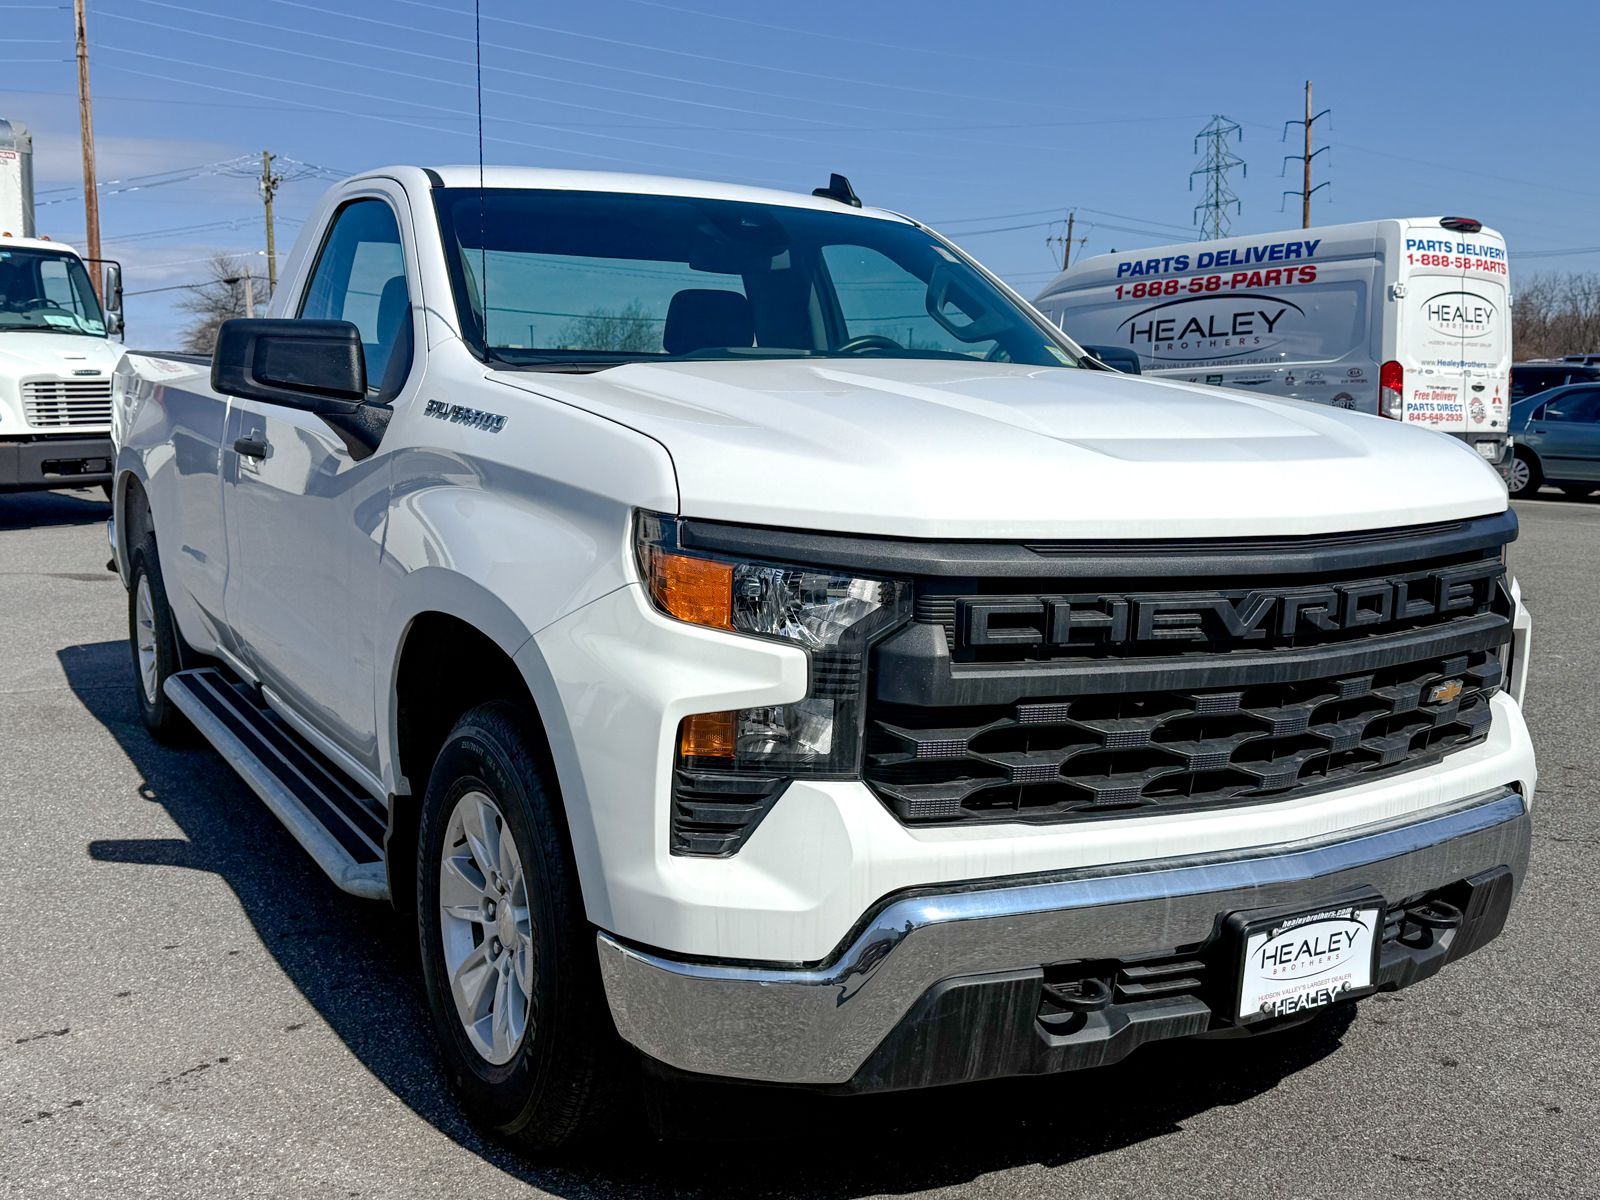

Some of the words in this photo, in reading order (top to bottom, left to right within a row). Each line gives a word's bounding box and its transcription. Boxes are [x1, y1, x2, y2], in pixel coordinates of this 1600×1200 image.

[1117, 255, 1190, 278] PARTS
[1197, 239, 1321, 269] DELIVERY
[1405, 239, 1453, 254] PARTS
[1456, 243, 1505, 260] DELIVERY
[1407, 253, 1507, 275] 1-888-58-PARTS
[1115, 265, 1318, 300] 1-888-58-PARTS
[1428, 304, 1493, 324] HEALEY
[1129, 308, 1288, 344] HEALEY
[1440, 322, 1485, 331] BROTHERS
[1154, 336, 1261, 351] BROTHERS
[1407, 403, 1435, 412] PARTS
[1436, 404, 1463, 412] DIRECT
[1413, 390, 1430, 401] Free
[1431, 391, 1458, 403] Delivery
[1282, 907, 1353, 929] healeybrothers.com
[1261, 927, 1360, 970] HEALEY
[1273, 953, 1340, 975] BROTHERS
[1258, 991, 1281, 1002] HUDSON
[1282, 984, 1306, 996] VALLEY'S
[1307, 978, 1331, 989] LARGEST
[1331, 973, 1352, 983] DEALER
[1275, 987, 1338, 1017] HEALEY
